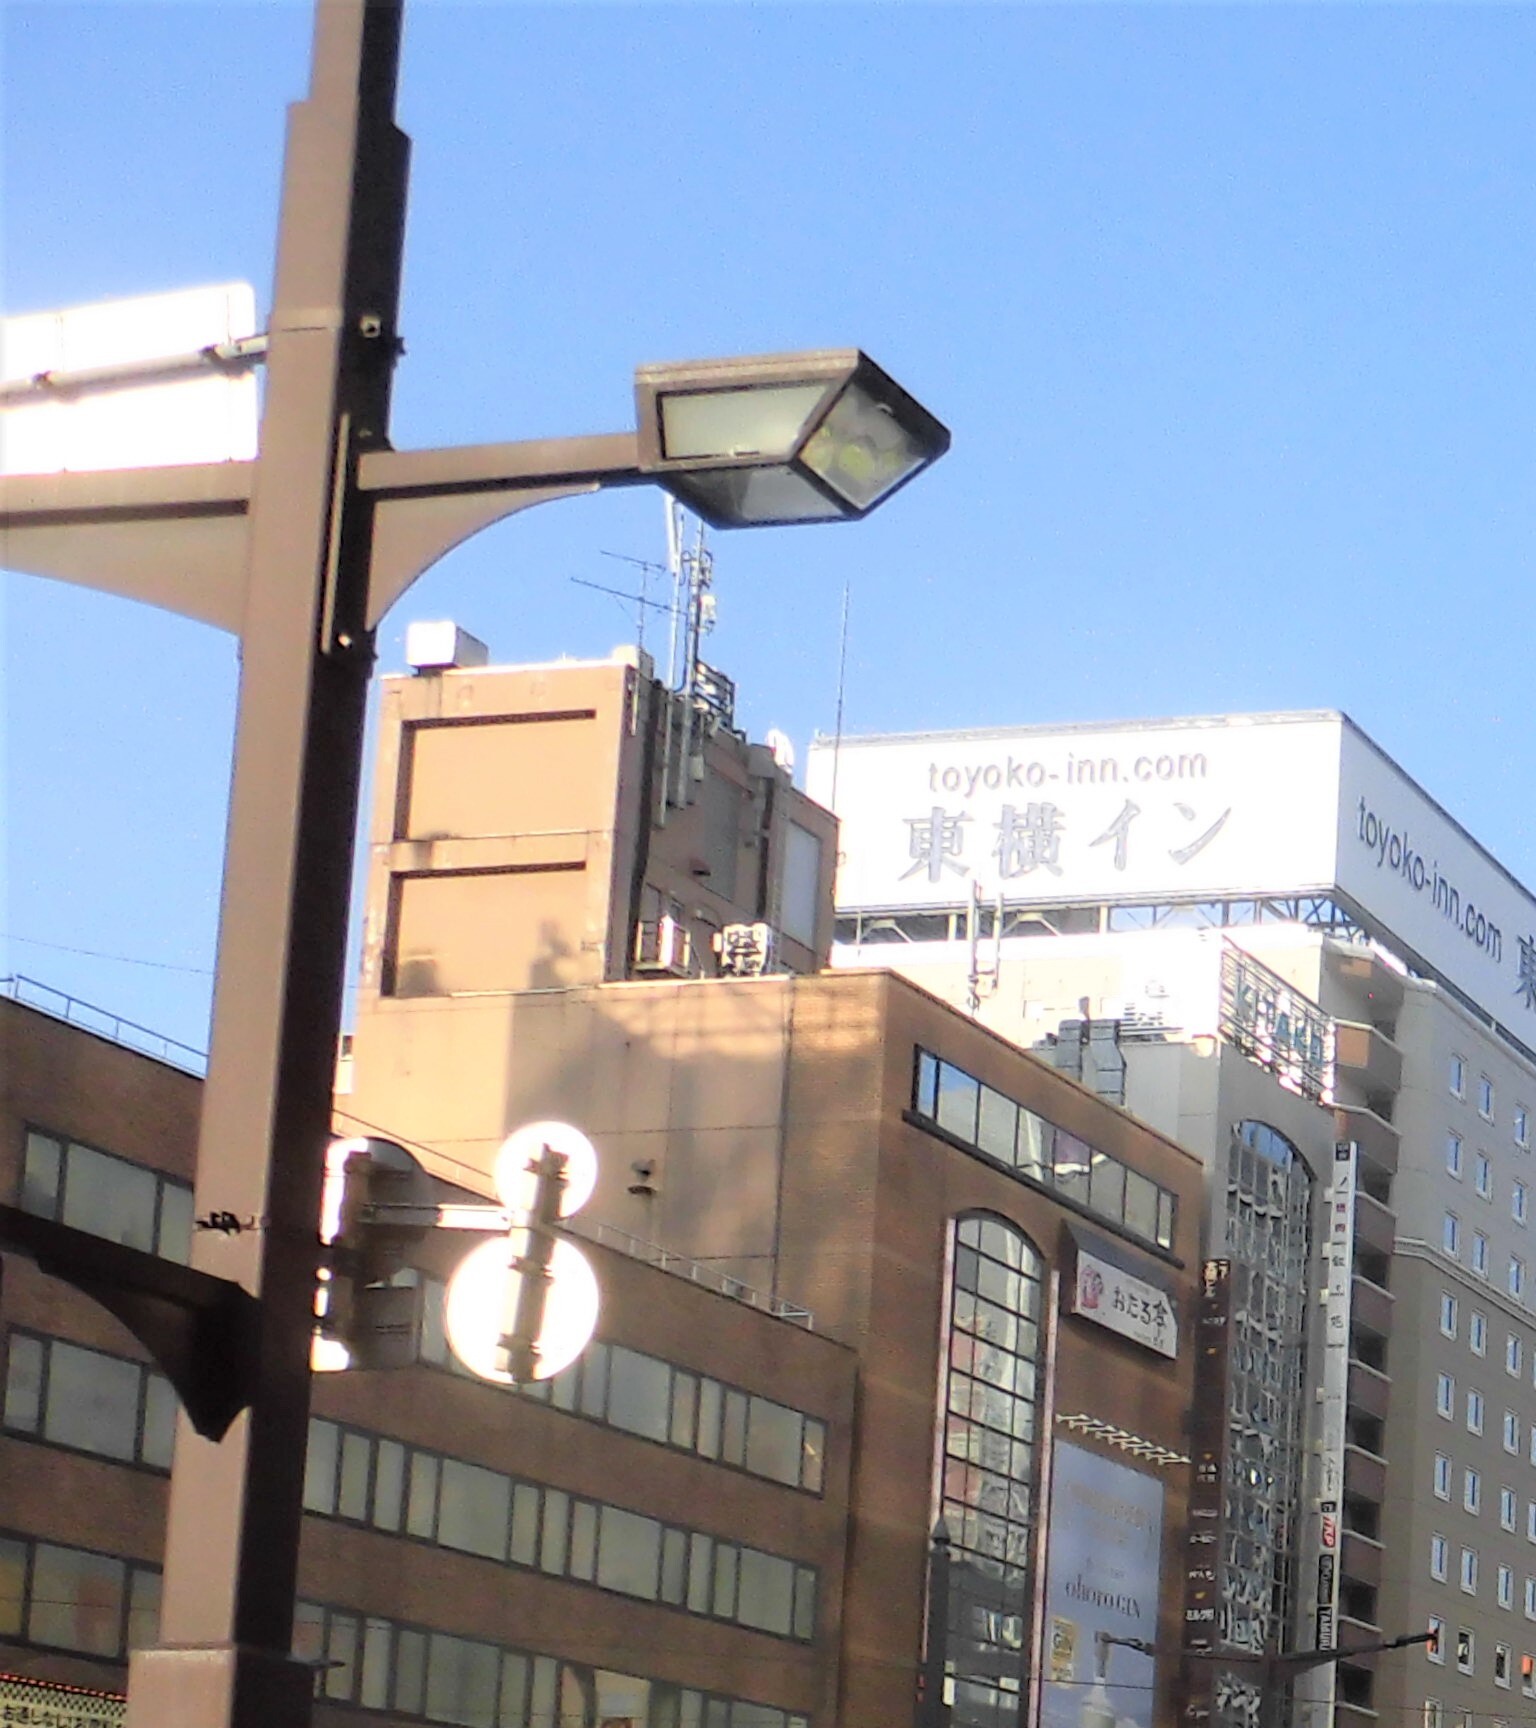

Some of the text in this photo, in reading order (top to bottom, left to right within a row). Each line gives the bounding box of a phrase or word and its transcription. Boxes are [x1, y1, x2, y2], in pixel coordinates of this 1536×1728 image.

[928, 752, 1208, 798] toyoko-inn.com
[898, 799, 1232, 884] 東横イン
[1358, 797, 1502, 963] toyoko-inn.com
